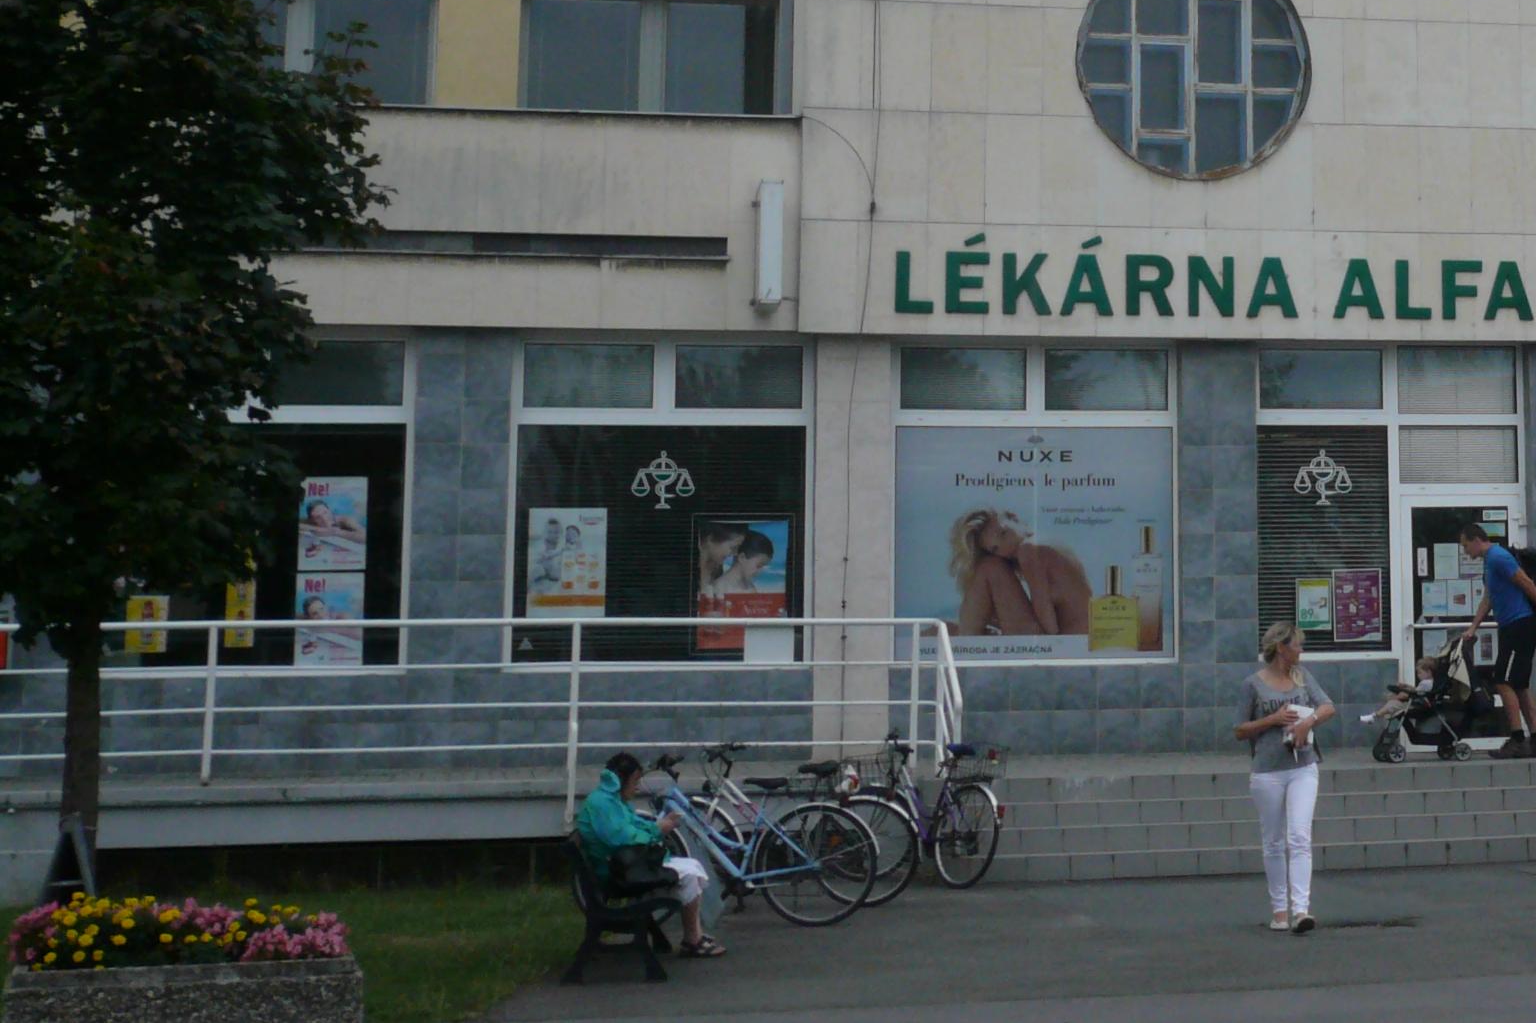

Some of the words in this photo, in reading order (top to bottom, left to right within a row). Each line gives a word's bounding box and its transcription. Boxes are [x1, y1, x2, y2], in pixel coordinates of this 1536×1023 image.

[894, 232, 1299, 319] LÉKÁRNA
[1333, 258, 1535, 322] ALFA
[998, 450, 1073, 463] NUXE
[308, 482, 330, 497] Ne!
[954, 473, 1035, 491] Prodigieux
[1044, 473, 1055, 487] le
[1061, 473, 1116, 491] parfum
[304, 578, 326, 594] Ne!
